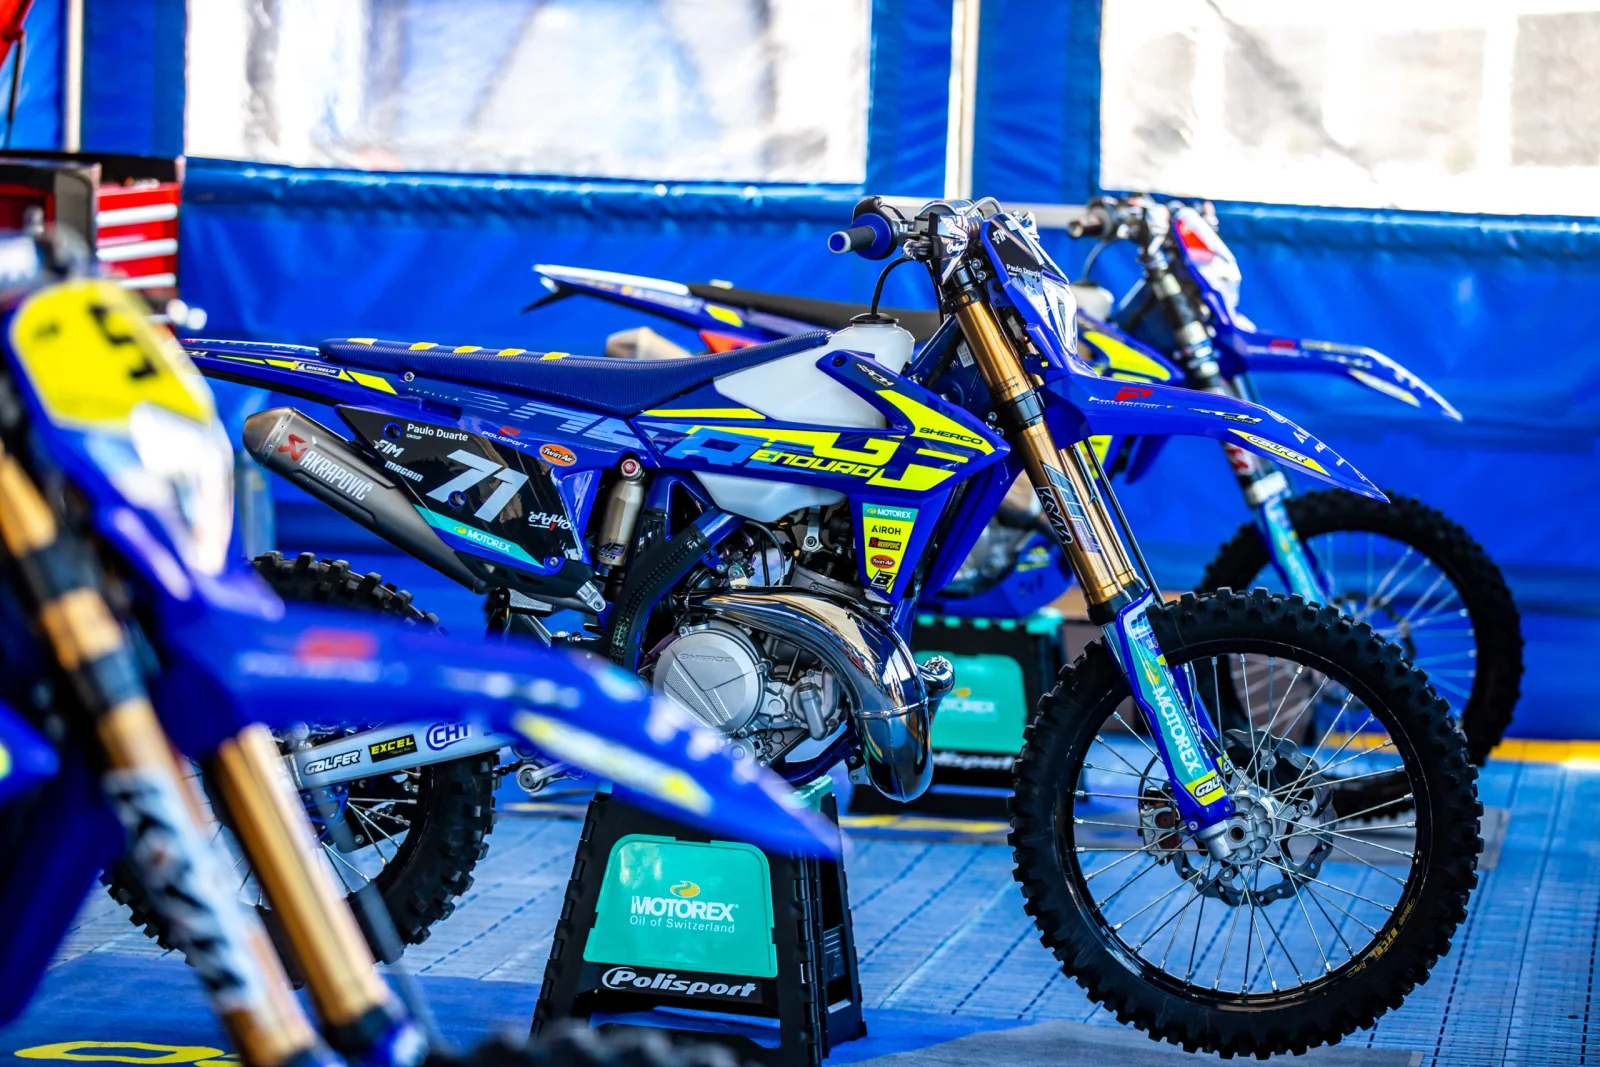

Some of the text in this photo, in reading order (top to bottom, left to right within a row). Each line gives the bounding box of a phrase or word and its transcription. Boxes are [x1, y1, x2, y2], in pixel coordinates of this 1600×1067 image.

[305, 364, 338, 375] MICHELIN
[407, 423, 469, 442] Paulo Duarte
[481, 430, 531, 449] POLISPORT
[919, 427, 983, 445] SHERCO
[377, 439, 405, 458] FIM
[543, 447, 575, 463] Twin Air
[1247, 435, 1308, 463] GALFER
[749, 449, 879, 478] ENDURO
[426, 449, 529, 523] 71
[877, 508, 912, 519] MOTOREX
[1036, 486, 1073, 545] KYB
[467, 529, 512, 553] MOTOREX
[871, 525, 902, 536] AIROH
[678, 653, 735, 663] SHERCO
[431, 723, 470, 746] CHT
[1152, 685, 1201, 777] MOTOREX
[370, 737, 414, 755] EXCEL
[303, 749, 361, 776] GALFER
[1194, 775, 1222, 799] GALF
[631, 895, 735, 922] MOTOREX
[629, 915, 735, 933] Oil of Switzerland
[1369, 927, 1399, 958] EXCEL
[603, 967, 757, 997] Polisport
